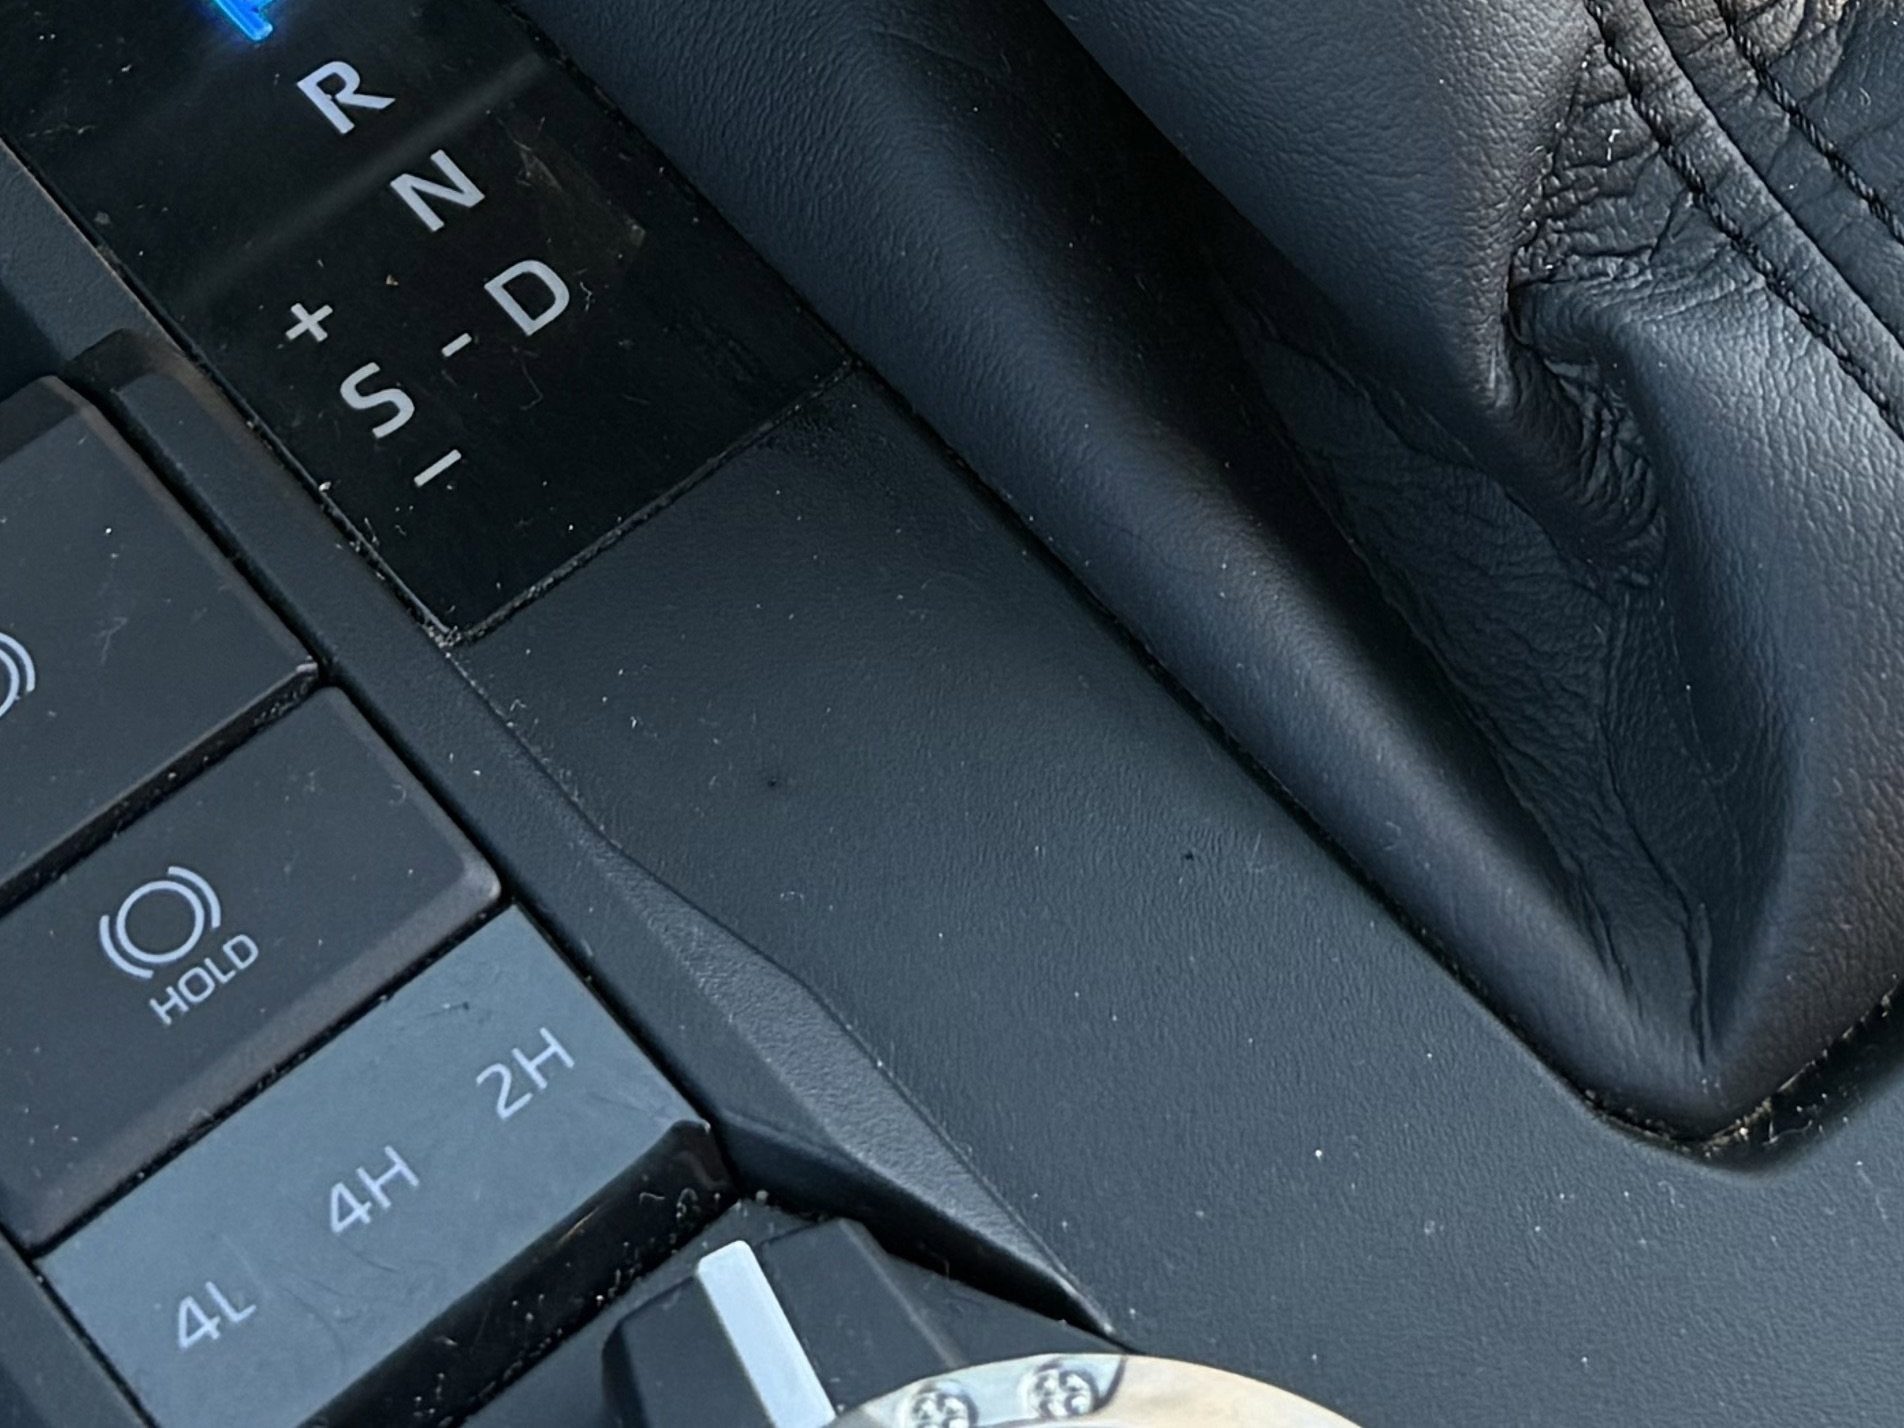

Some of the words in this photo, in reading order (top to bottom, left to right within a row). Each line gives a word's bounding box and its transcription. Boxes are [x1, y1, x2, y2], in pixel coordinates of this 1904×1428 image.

[297, 59, 395, 134] R
[390, 148, 485, 232] N
[339, 361, 415, 439] S
[483, 258, 571, 336] D
[149, 934, 259, 1026] HOLD
[476, 1027, 576, 1120] 2H
[330, 1144, 420, 1234] 4H
[178, 1280, 257, 1350] 4L
